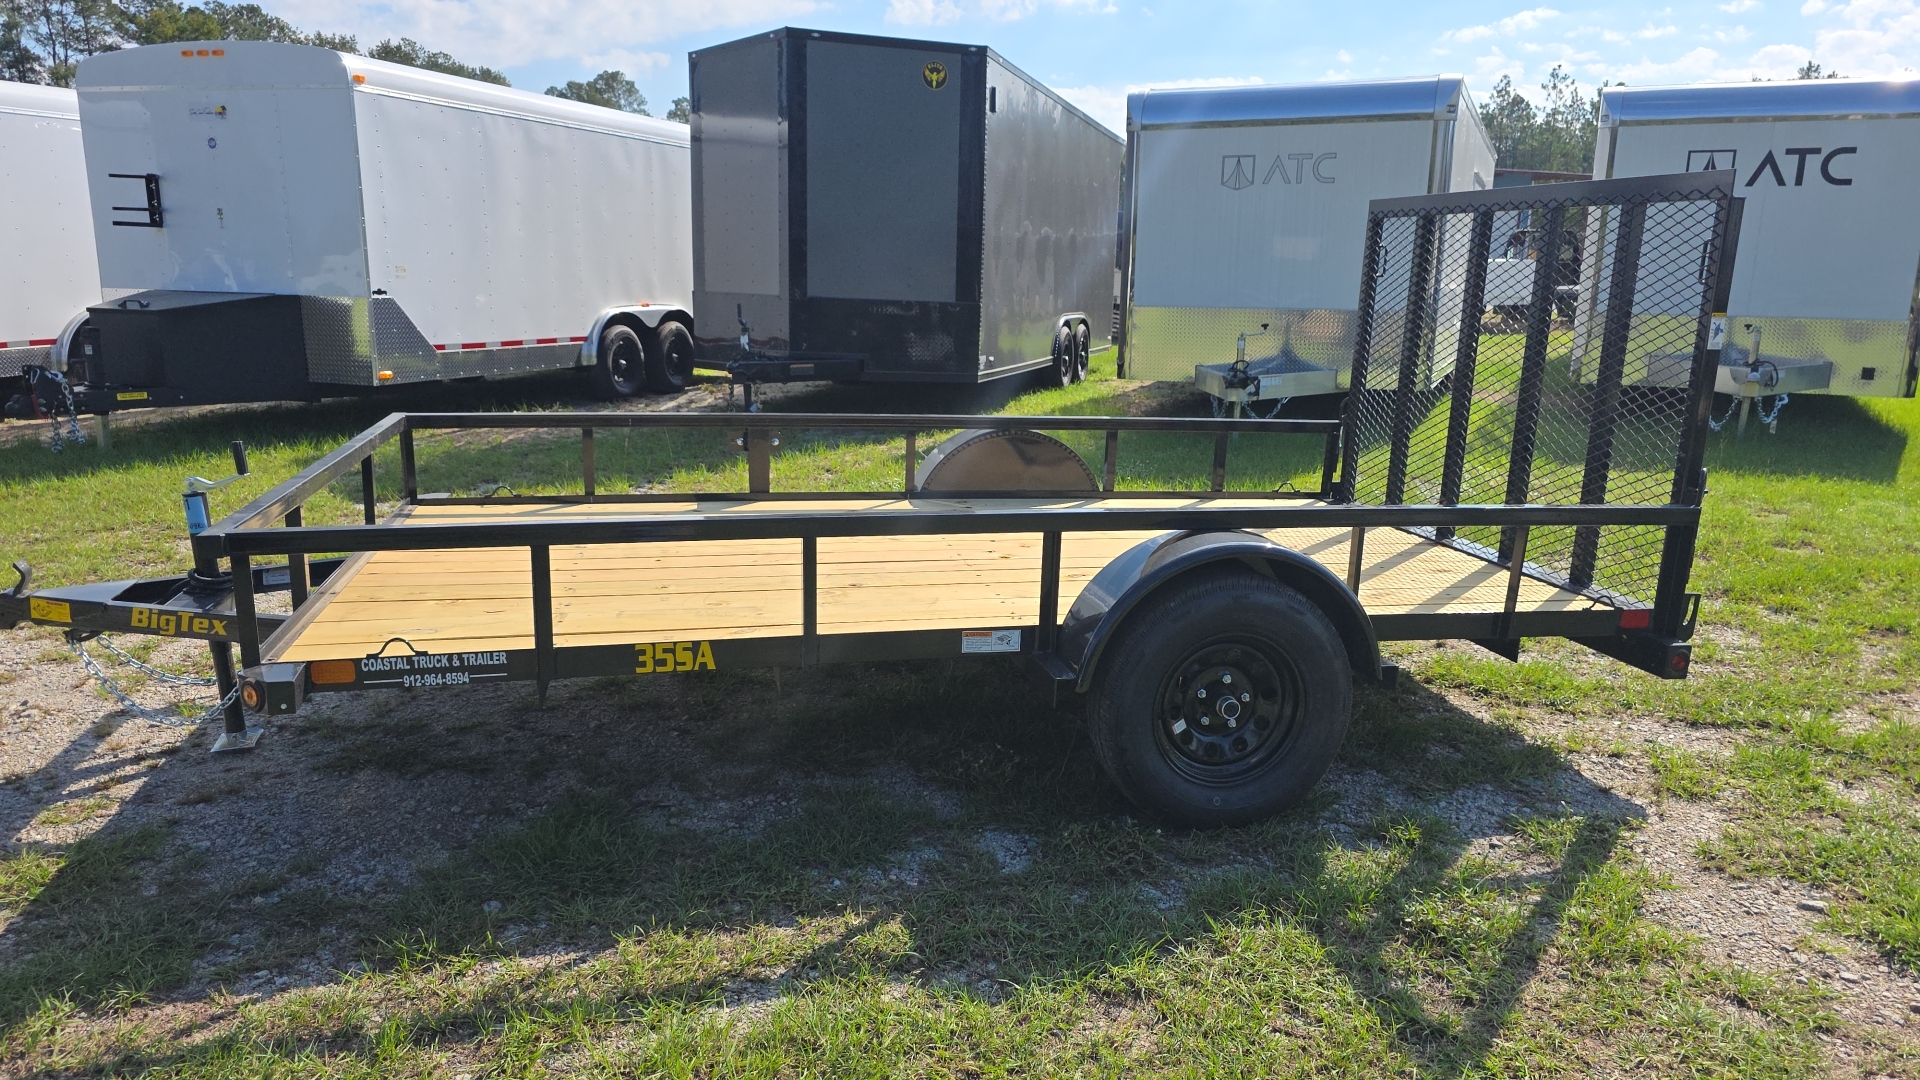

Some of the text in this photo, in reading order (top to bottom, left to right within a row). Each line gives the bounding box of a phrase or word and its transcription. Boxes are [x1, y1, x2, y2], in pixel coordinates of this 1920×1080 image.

[1262, 152, 1338, 185] ATC
[1744, 146, 1858, 187] ATC
[131, 607, 228, 636] BigTex
[361, 652, 507, 672] COASTAL TRUCK & TRAILER
[635, 641, 717, 673] 35SA
[403, 672, 470, 687] 912-964-8594
